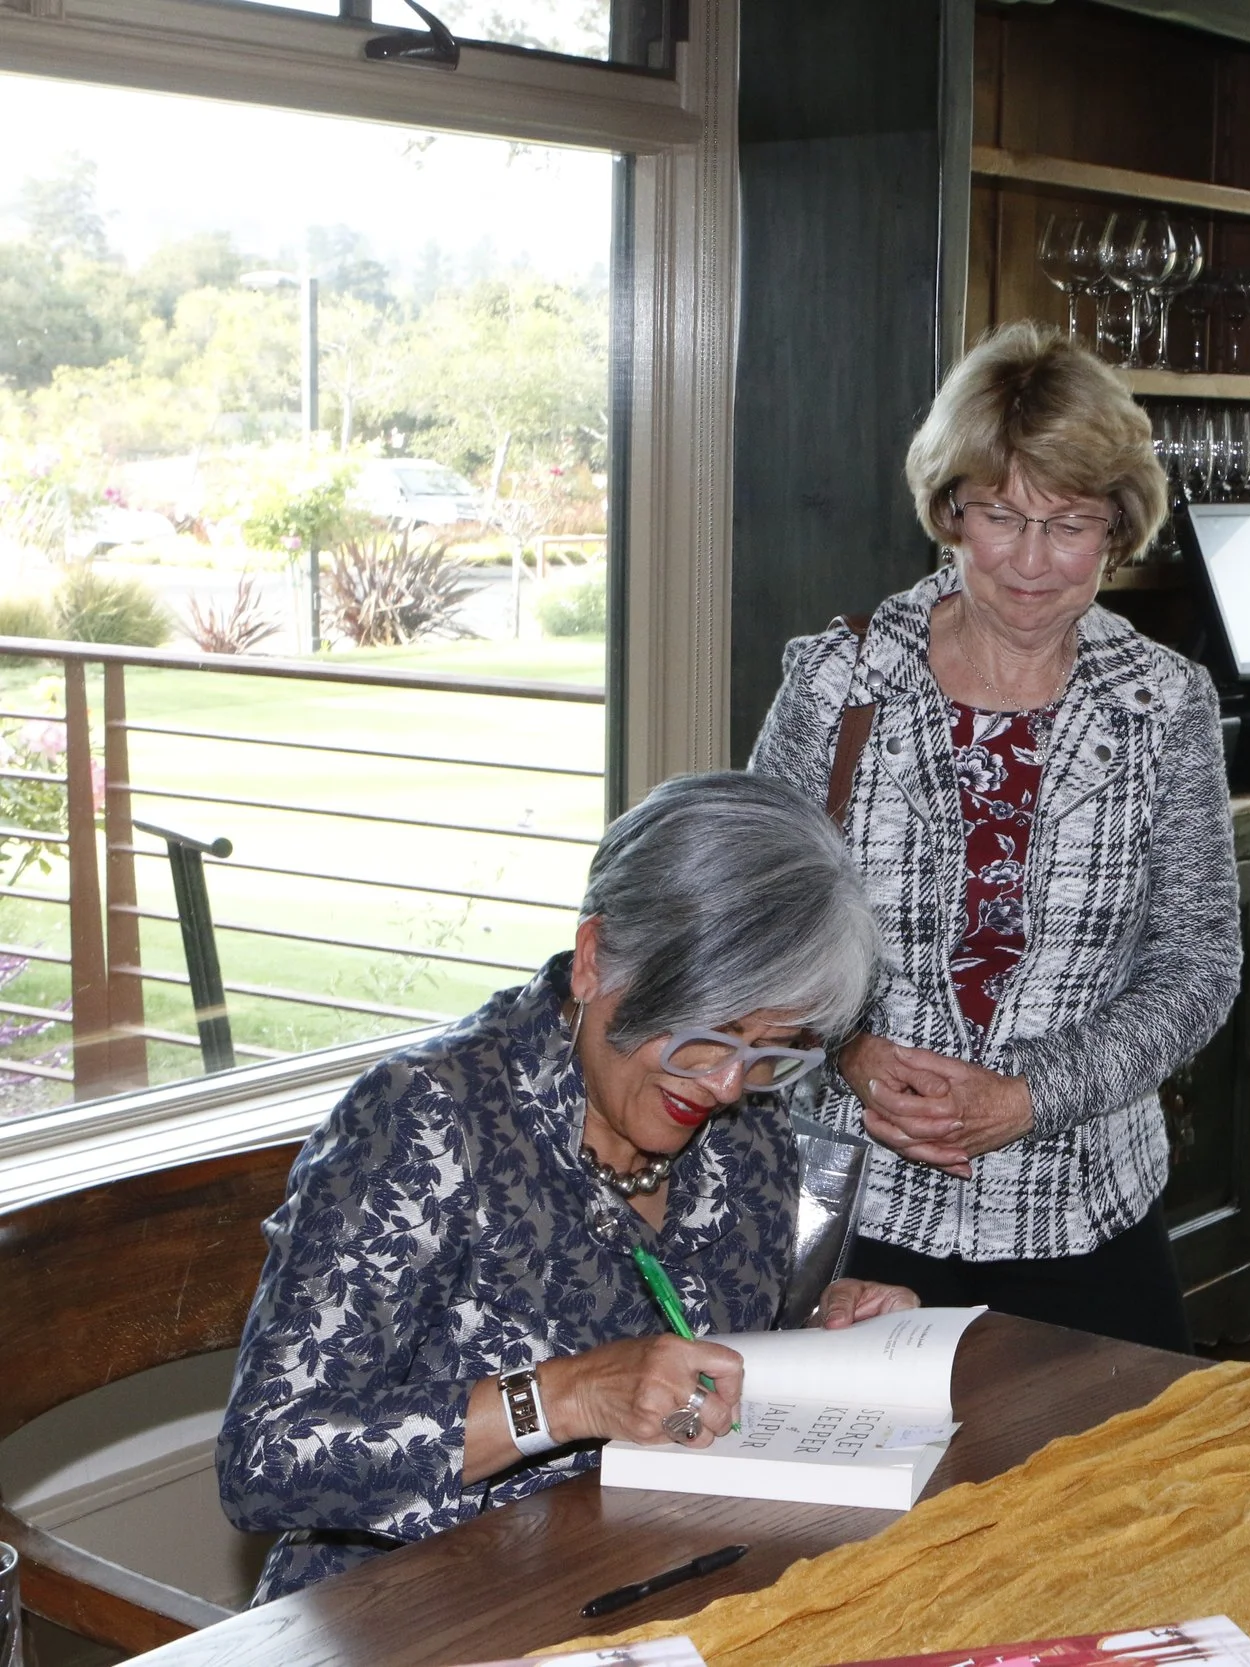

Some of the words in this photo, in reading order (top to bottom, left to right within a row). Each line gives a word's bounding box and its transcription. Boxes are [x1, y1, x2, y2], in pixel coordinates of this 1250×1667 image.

[739, 1402, 796, 1449] JAIPUR
[793, 1406, 849, 1454] KEEPER
[832, 1408, 885, 1457] SECRET
